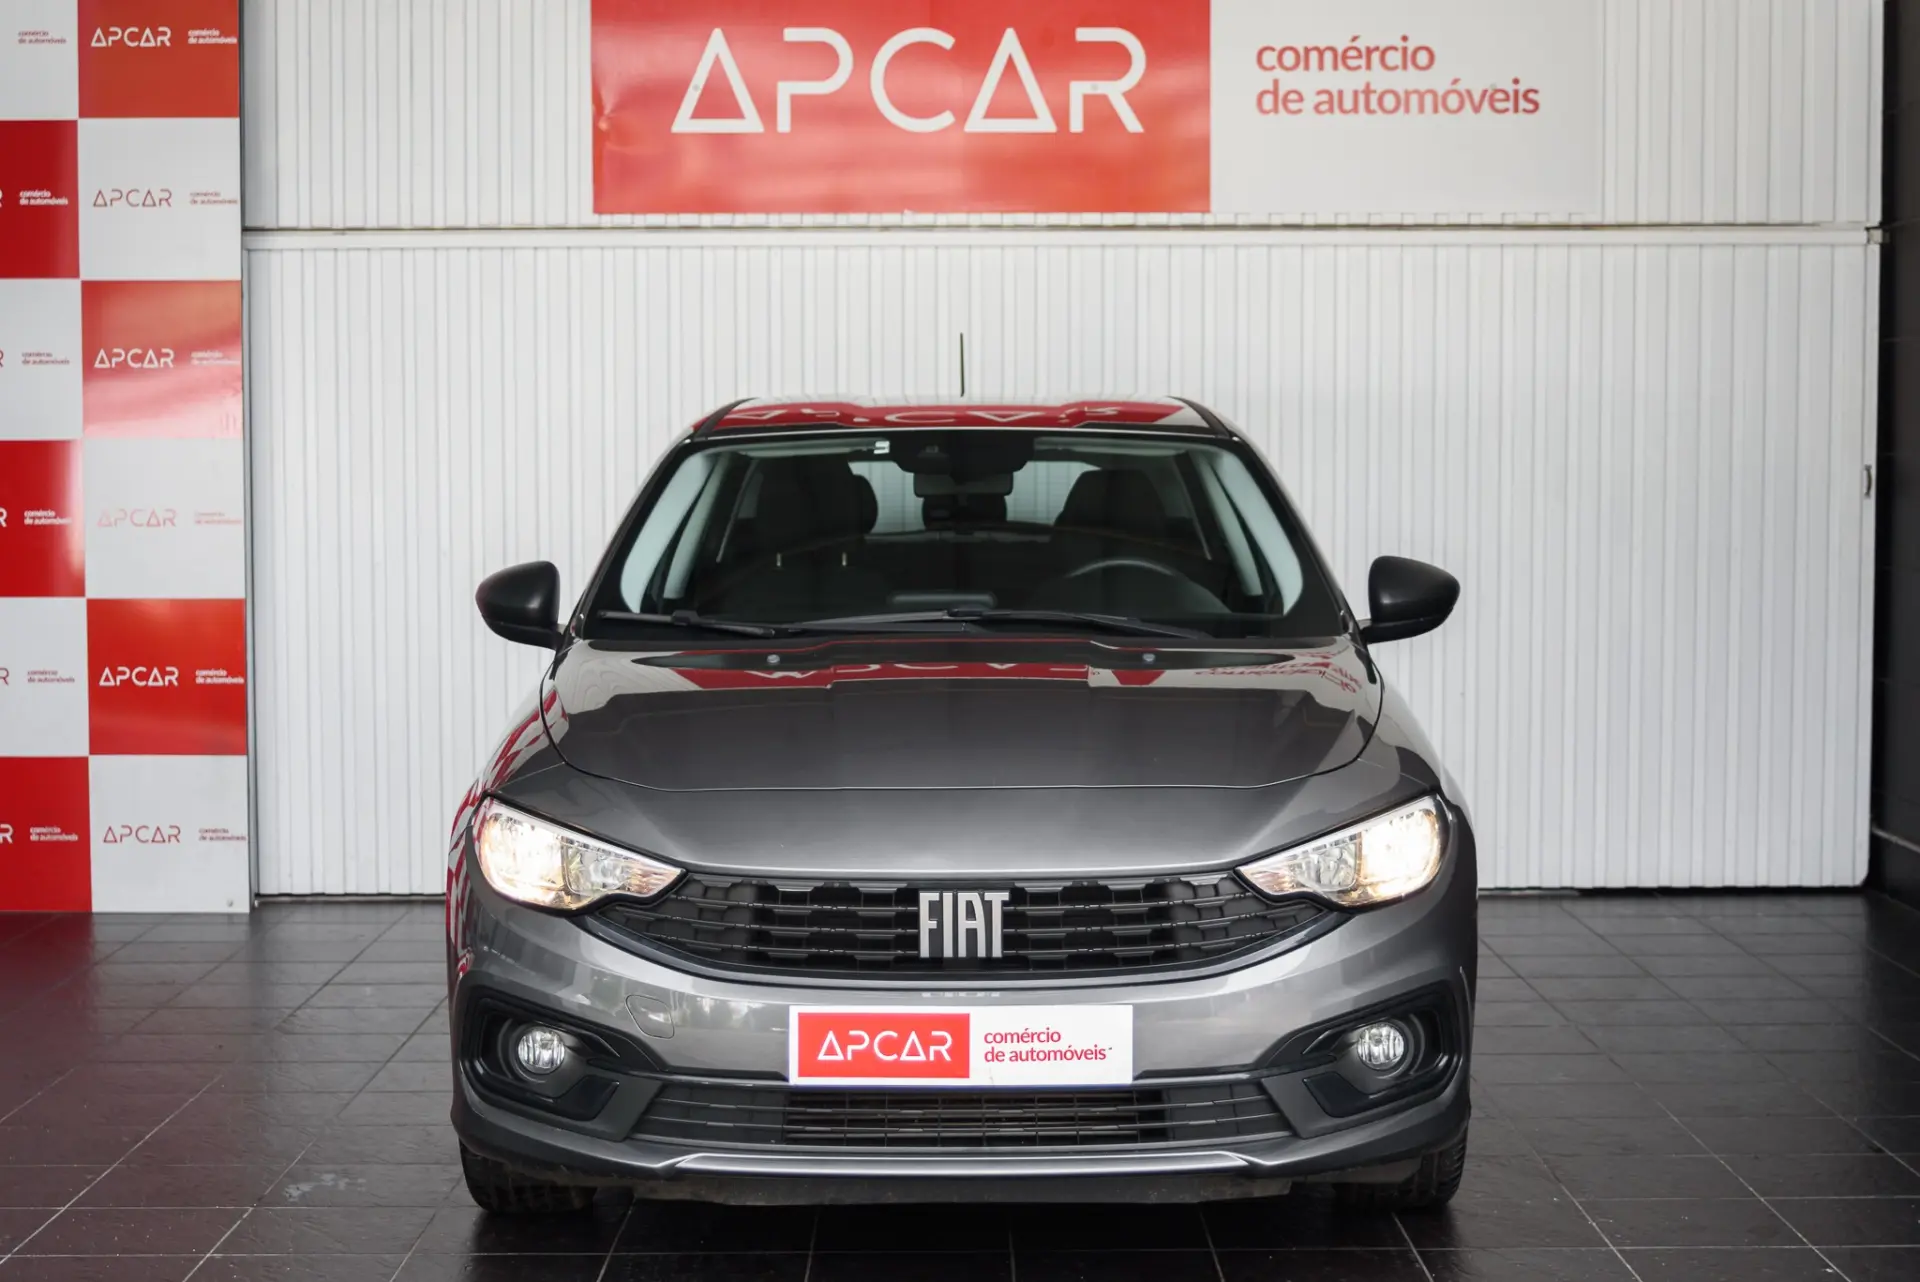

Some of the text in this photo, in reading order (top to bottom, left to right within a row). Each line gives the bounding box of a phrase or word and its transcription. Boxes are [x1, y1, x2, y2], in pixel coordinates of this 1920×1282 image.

[91, 27, 171, 47] APCAR
[1256, 35, 1436, 73] comércio
[670, 26, 1147, 133] APCAR
[1256, 77, 1541, 115] de automóveis
[93, 189, 172, 207] APCAR
[94, 348, 175, 368] APCAR
[97, 508, 177, 528] APCAR
[99, 667, 178, 687] APCAR
[103, 824, 181, 843] APCAR
[917, 889, 1011, 959] FIAT
[817, 1030, 952, 1062] APCAR
[984, 1027, 1062, 1045] comércio
[984, 1045, 1106, 1063] de automóveis
